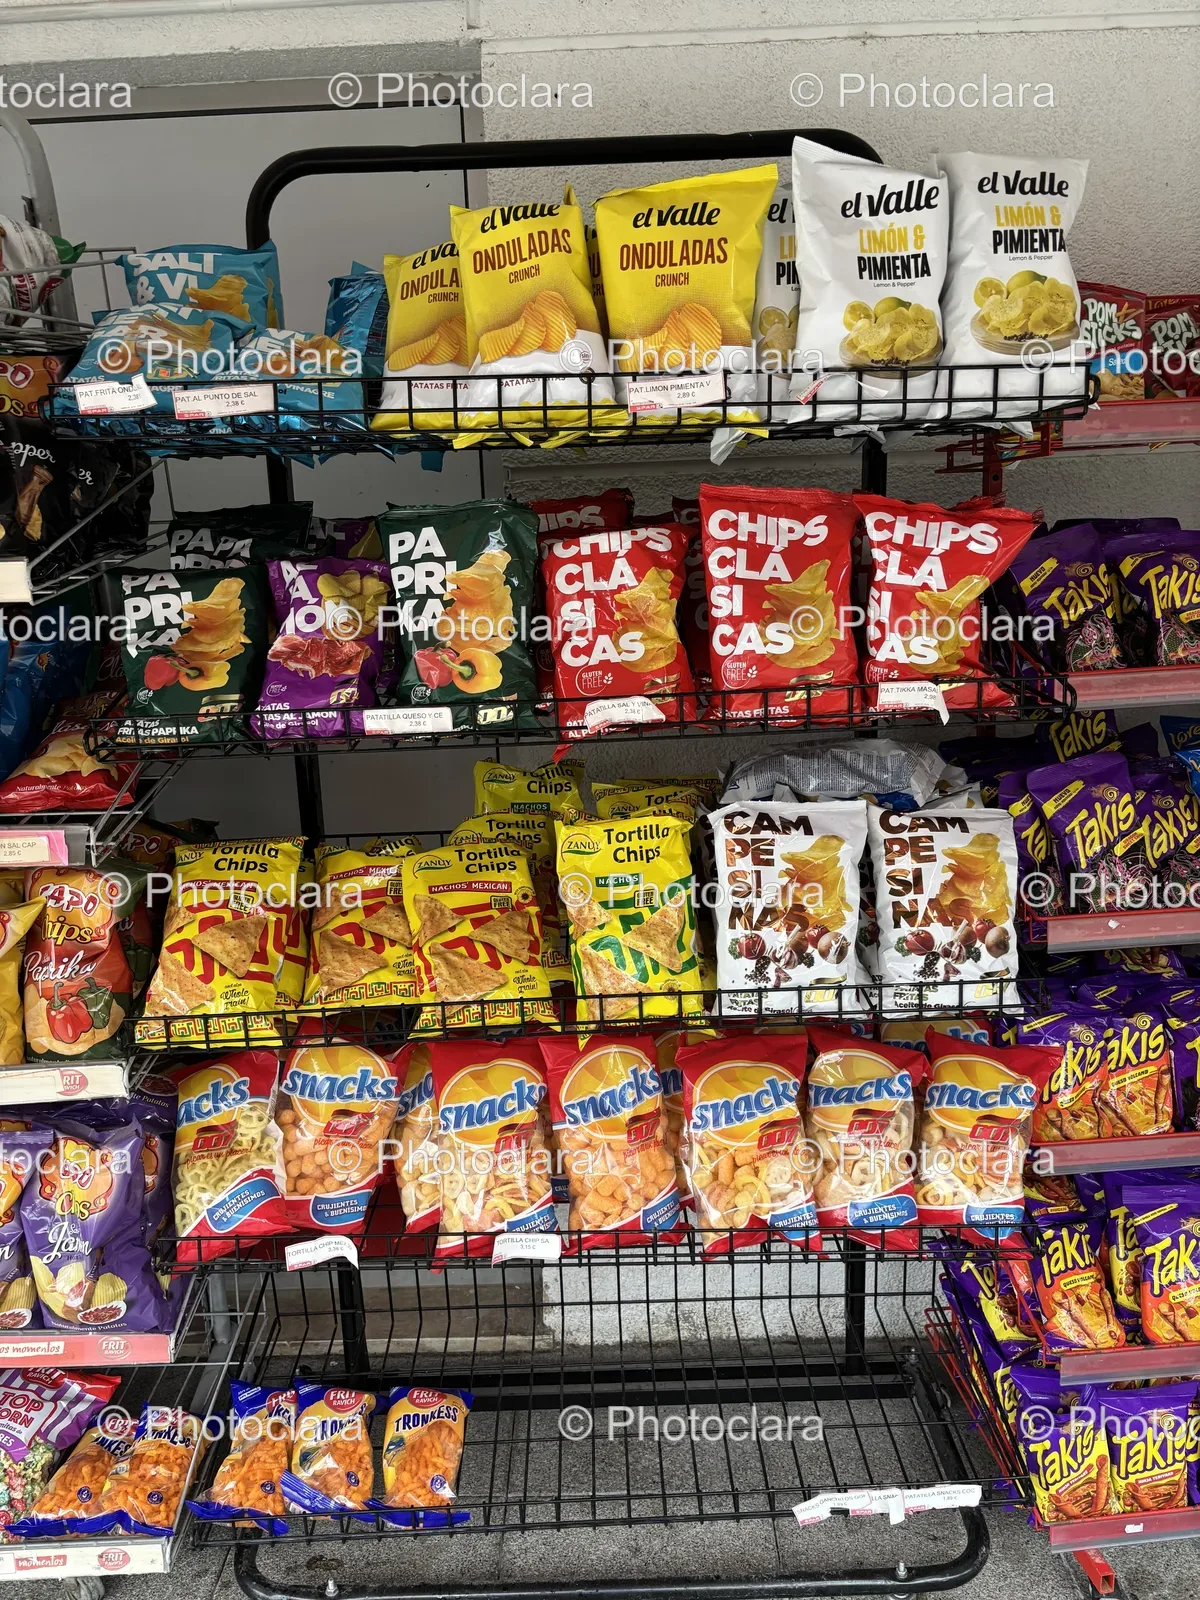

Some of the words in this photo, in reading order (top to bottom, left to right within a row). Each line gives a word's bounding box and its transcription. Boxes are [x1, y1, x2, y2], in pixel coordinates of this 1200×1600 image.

[995, 201, 1045, 227] LIMÓN
[1051, 206, 1062, 226] &
[859, 223, 909, 253] LIMÓN
[913, 224, 926, 250] &
[993, 228, 1067, 254] PIMIENTA
[473, 229, 573, 274] ONDULADAS
[620, 237, 728, 271] ONDULADAS
[127, 252, 222, 277] SALT
[509, 264, 540, 284] CRUNCH
[857, 253, 931, 280] PIMIENTA
[655, 272, 689, 287] CRUNCH
[428, 292, 459, 303] CRUNCH
[1083, 298, 1118, 325] POM
[1151, 311, 1196, 346] POM
[203, 393, 230, 402] PUNTO
[629, 384, 668, 394] PAT.LIMON
[670, 381, 705, 391] PIMIENTA
[708, 508, 828, 549] CHIPS
[865, 511, 998, 554] CHIPS
[389, 526, 446, 564] PA
[553, 527, 672, 558] CHIPS
[555, 549, 638, 595] CLÁ
[708, 545, 792, 582] CLÁ
[871, 548, 947, 592] CLÁ
[121, 572, 181, 595] PA
[391, 560, 457, 598] PRI
[710, 584, 743, 618] SI
[397, 598, 445, 635] KA
[561, 598, 596, 631] SI
[561, 631, 646, 667] CAS
[712, 622, 795, 656] CAS
[582, 670, 602, 678] GLUTEN
[582, 678, 603, 688] FREE
[726, 668, 747, 681] FREE
[526, 780, 572, 795] Chips
[486, 820, 546, 832] Tortilla
[604, 824, 670, 845] Tortilla
[724, 811, 813, 836] CAM
[879, 810, 970, 834] CAM
[496, 832, 541, 844] Chips
[567, 840, 601, 851] ZANUY
[212, 843, 279, 859] Tortilla
[416, 859, 452, 868] ZANUY
[455, 847, 521, 862] Tortilla
[613, 845, 661, 864] Chips
[725, 838, 775, 867] PE
[884, 836, 937, 866] PE
[214, 858, 268, 873] Chips
[465, 860, 517, 874] Chips
[472, 882, 508, 890] MEXICAN
[598, 875, 639, 885] NACHOS
[727, 870, 761, 899] SI
[886, 867, 924, 897] SI
[513, 975, 536, 985] Whole
[282, 1066, 399, 1101] snacks
[564, 1065, 663, 1127] snacks
[440, 1078, 548, 1134] snacks
[692, 1077, 800, 1132] snacks
[925, 1082, 1037, 1111] snacks
[213, 1189, 249, 1221] CRUJIENTES
[317, 1200, 358, 1210] CRUJIENTES
[855, 1204, 896, 1217] CRUJIENTES
[971, 1213, 1014, 1222] CRUJIENTES
[288, 1247, 317, 1257] TORTILLA
[497, 1237, 523, 1245] TORTILLA
[102, 1341, 126, 1350] FRIT
[330, 1388, 356, 1400] FRIT
[415, 1396, 438, 1404] RAVICH
[395, 1405, 458, 1432] TRONKESS
[102, 1552, 125, 1561] FRIT
